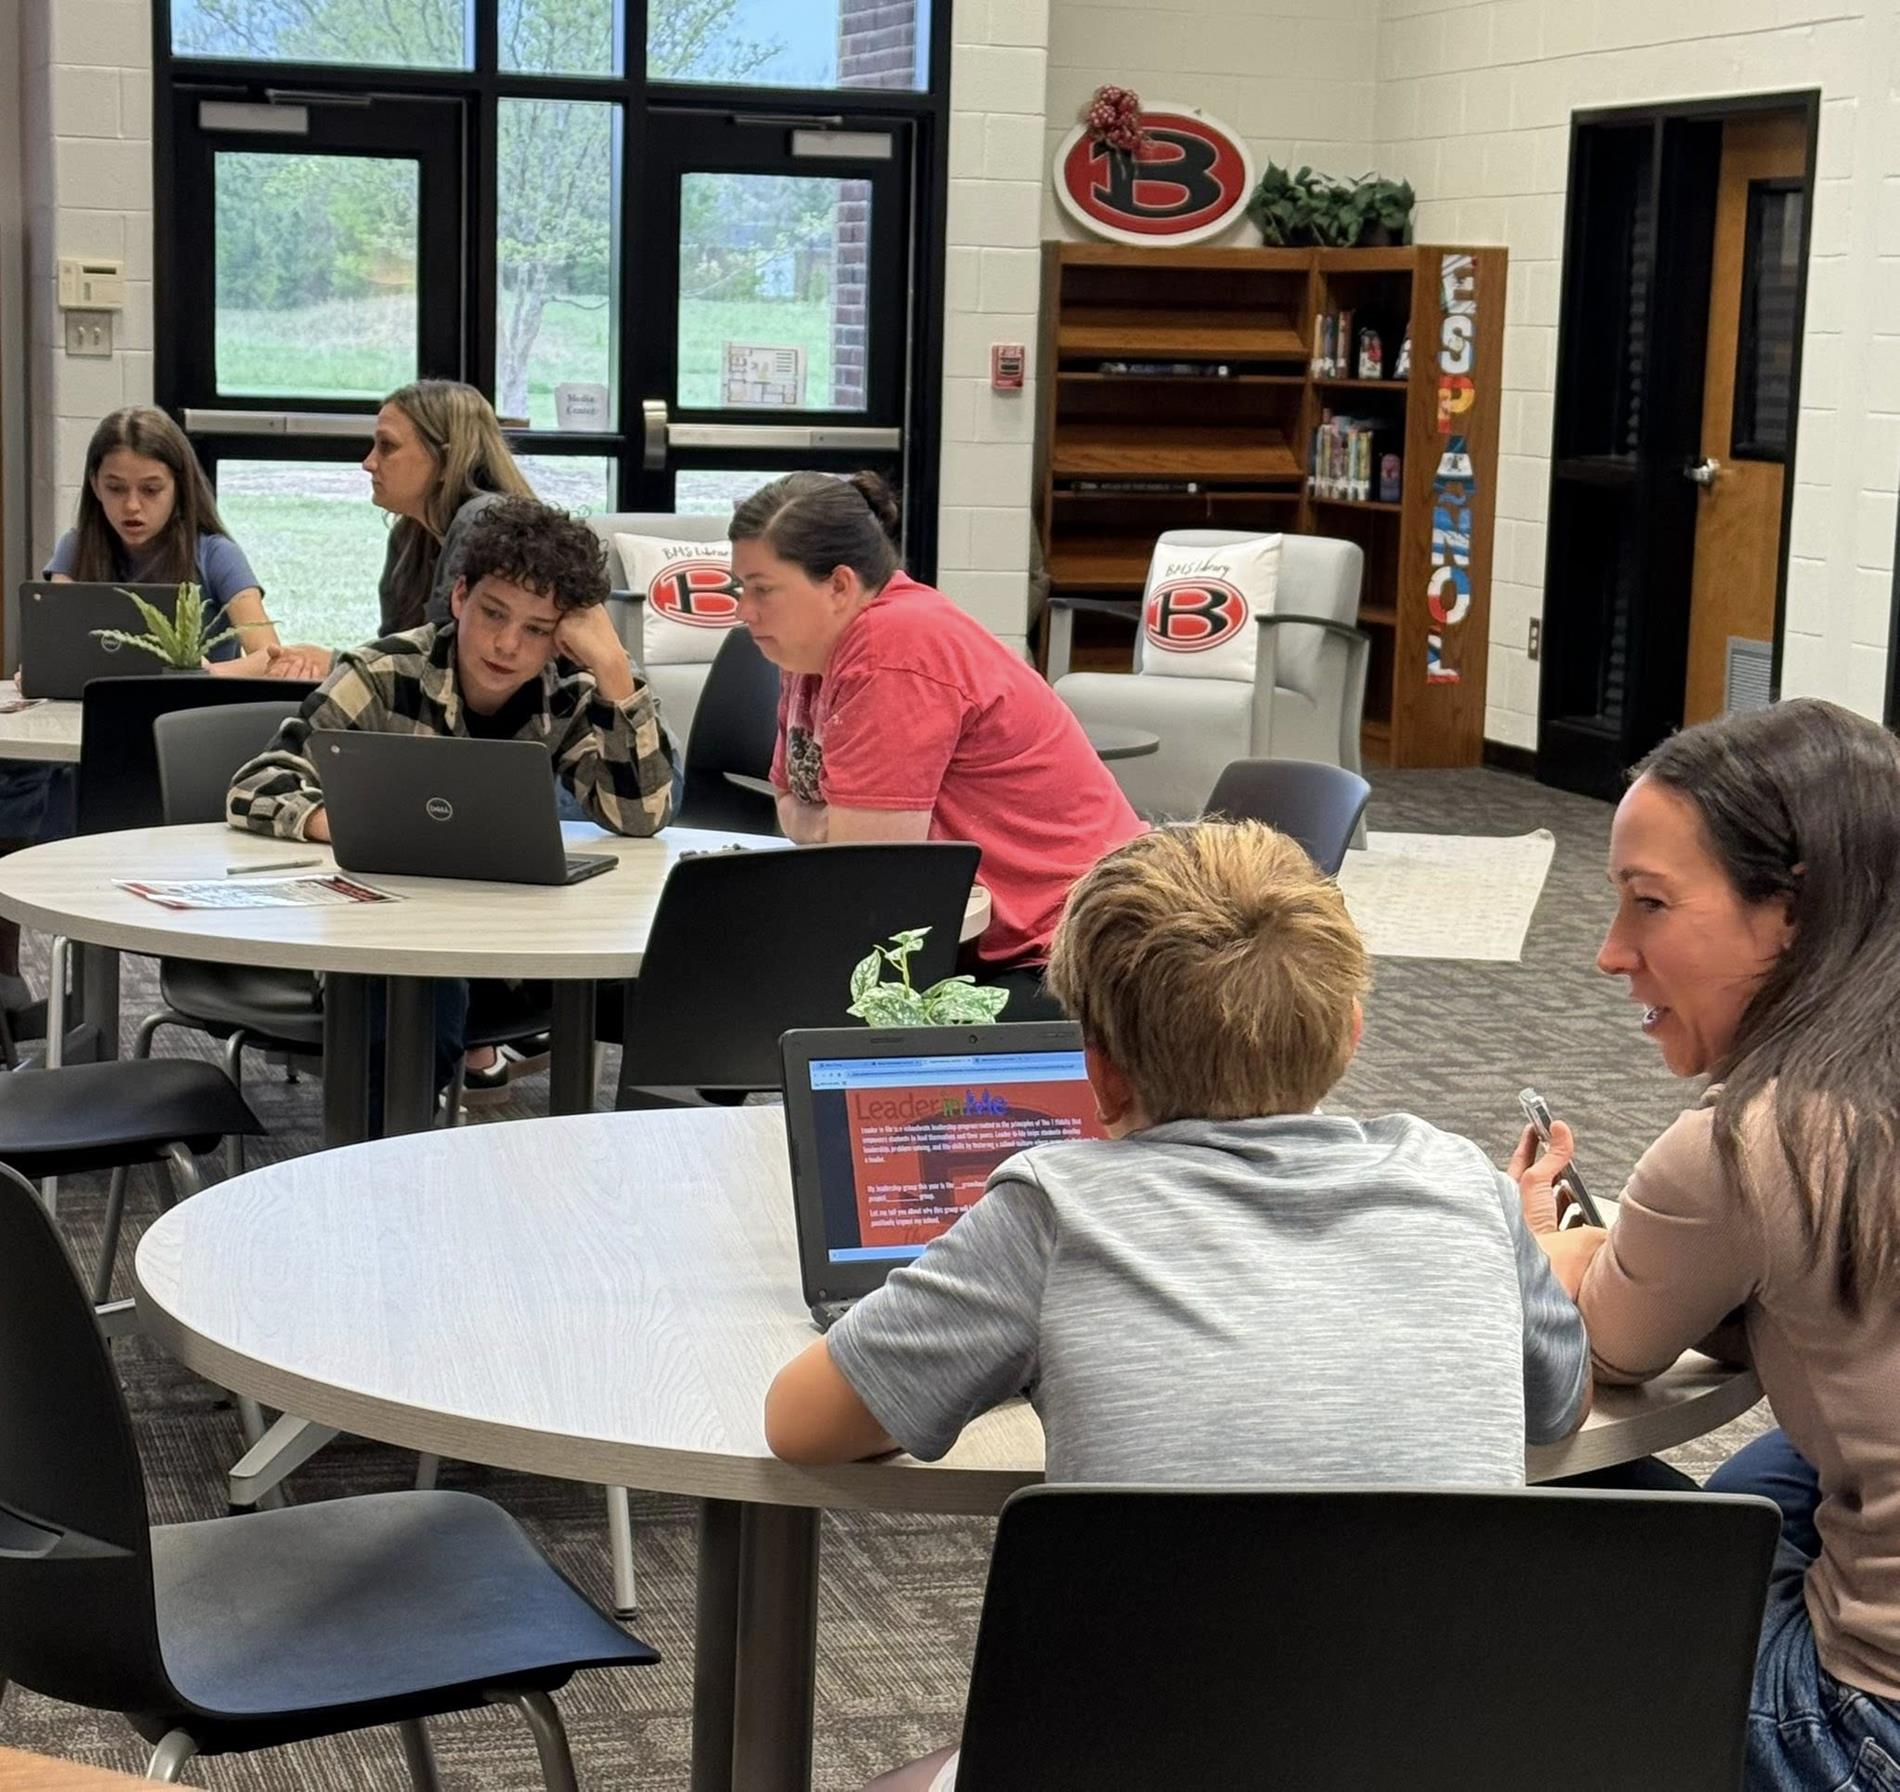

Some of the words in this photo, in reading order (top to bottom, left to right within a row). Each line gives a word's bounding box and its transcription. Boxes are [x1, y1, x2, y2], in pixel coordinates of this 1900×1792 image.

[1089, 127, 1224, 221] B
[663, 547, 693, 560] BMS
[695, 546, 730, 557] Librar
[1165, 562, 1193, 577] BMS
[1194, 555, 1231, 579] Library
[660, 568, 744, 617] B
[1149, 586, 1232, 642] B
[855, 1092, 939, 1120] Leader
